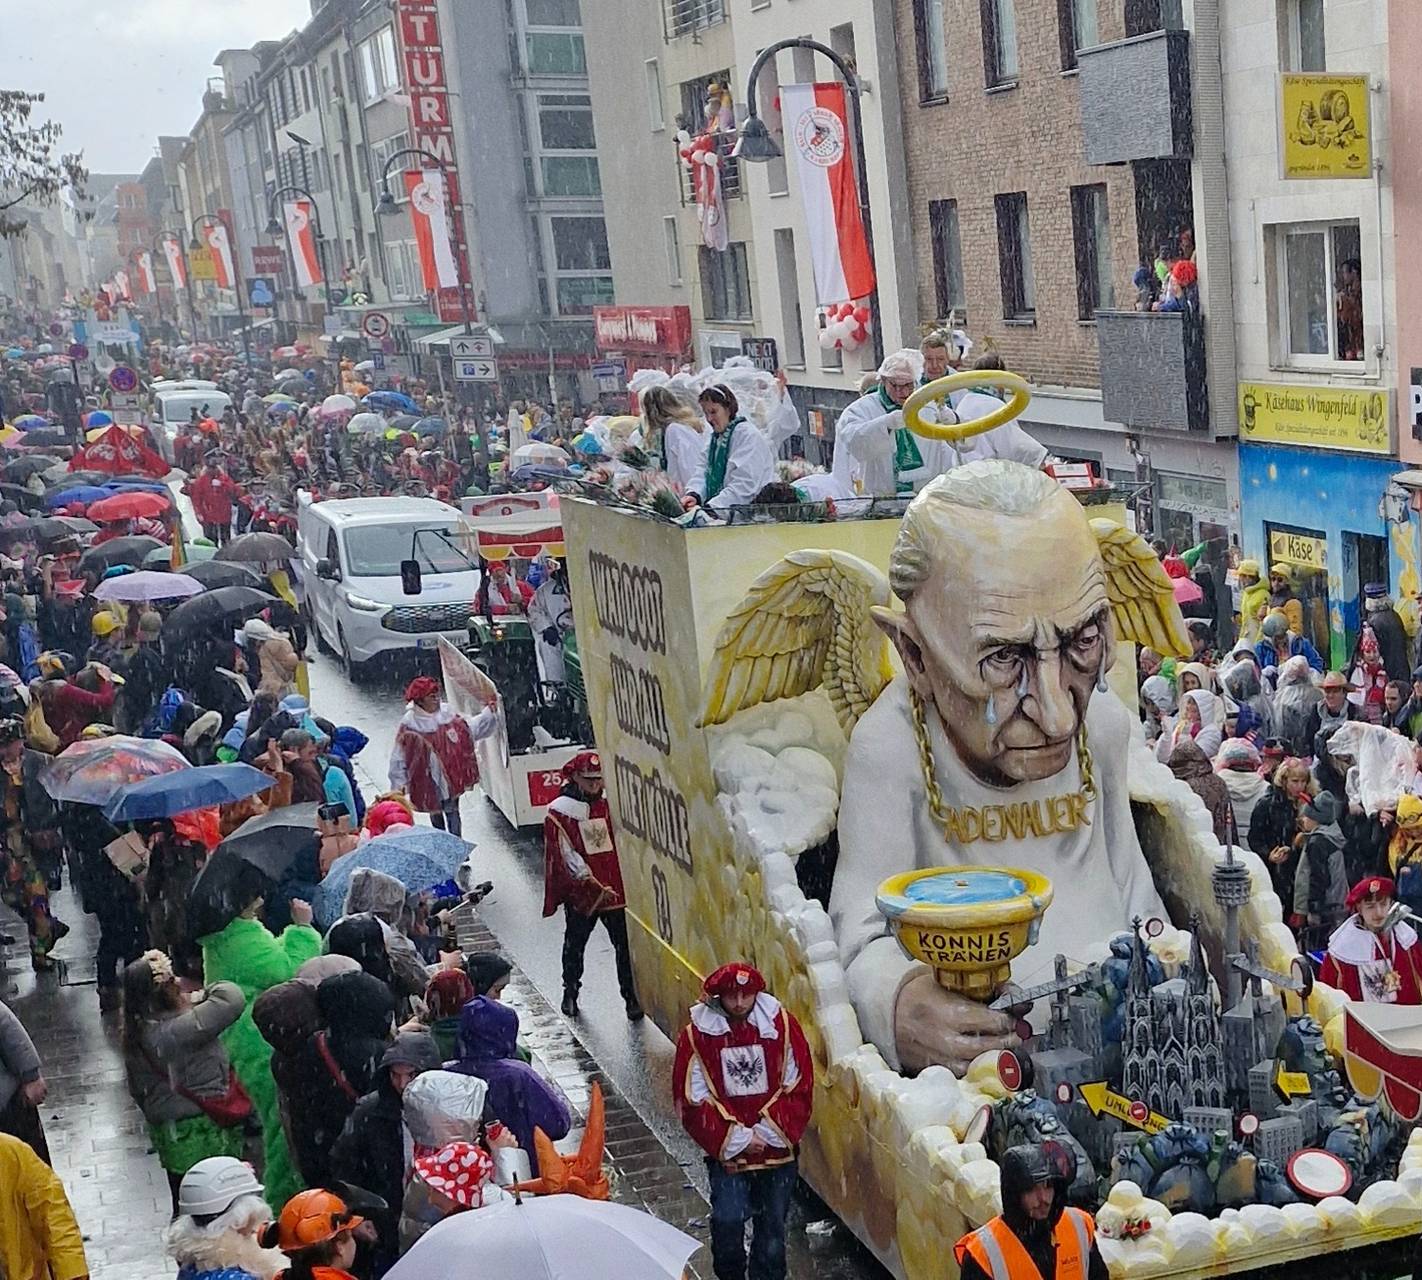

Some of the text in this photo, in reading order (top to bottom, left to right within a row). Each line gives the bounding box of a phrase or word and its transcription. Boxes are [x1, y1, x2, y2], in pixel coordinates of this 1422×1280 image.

[1265, 391, 1359, 422] Käsehaus Wingenfeld
[1288, 534, 1313, 562] Käse
[944, 793, 1092, 844] ADENAUER
[918, 931, 1010, 950] KONNIS
[922, 946, 1011, 962] TRÄNEN
